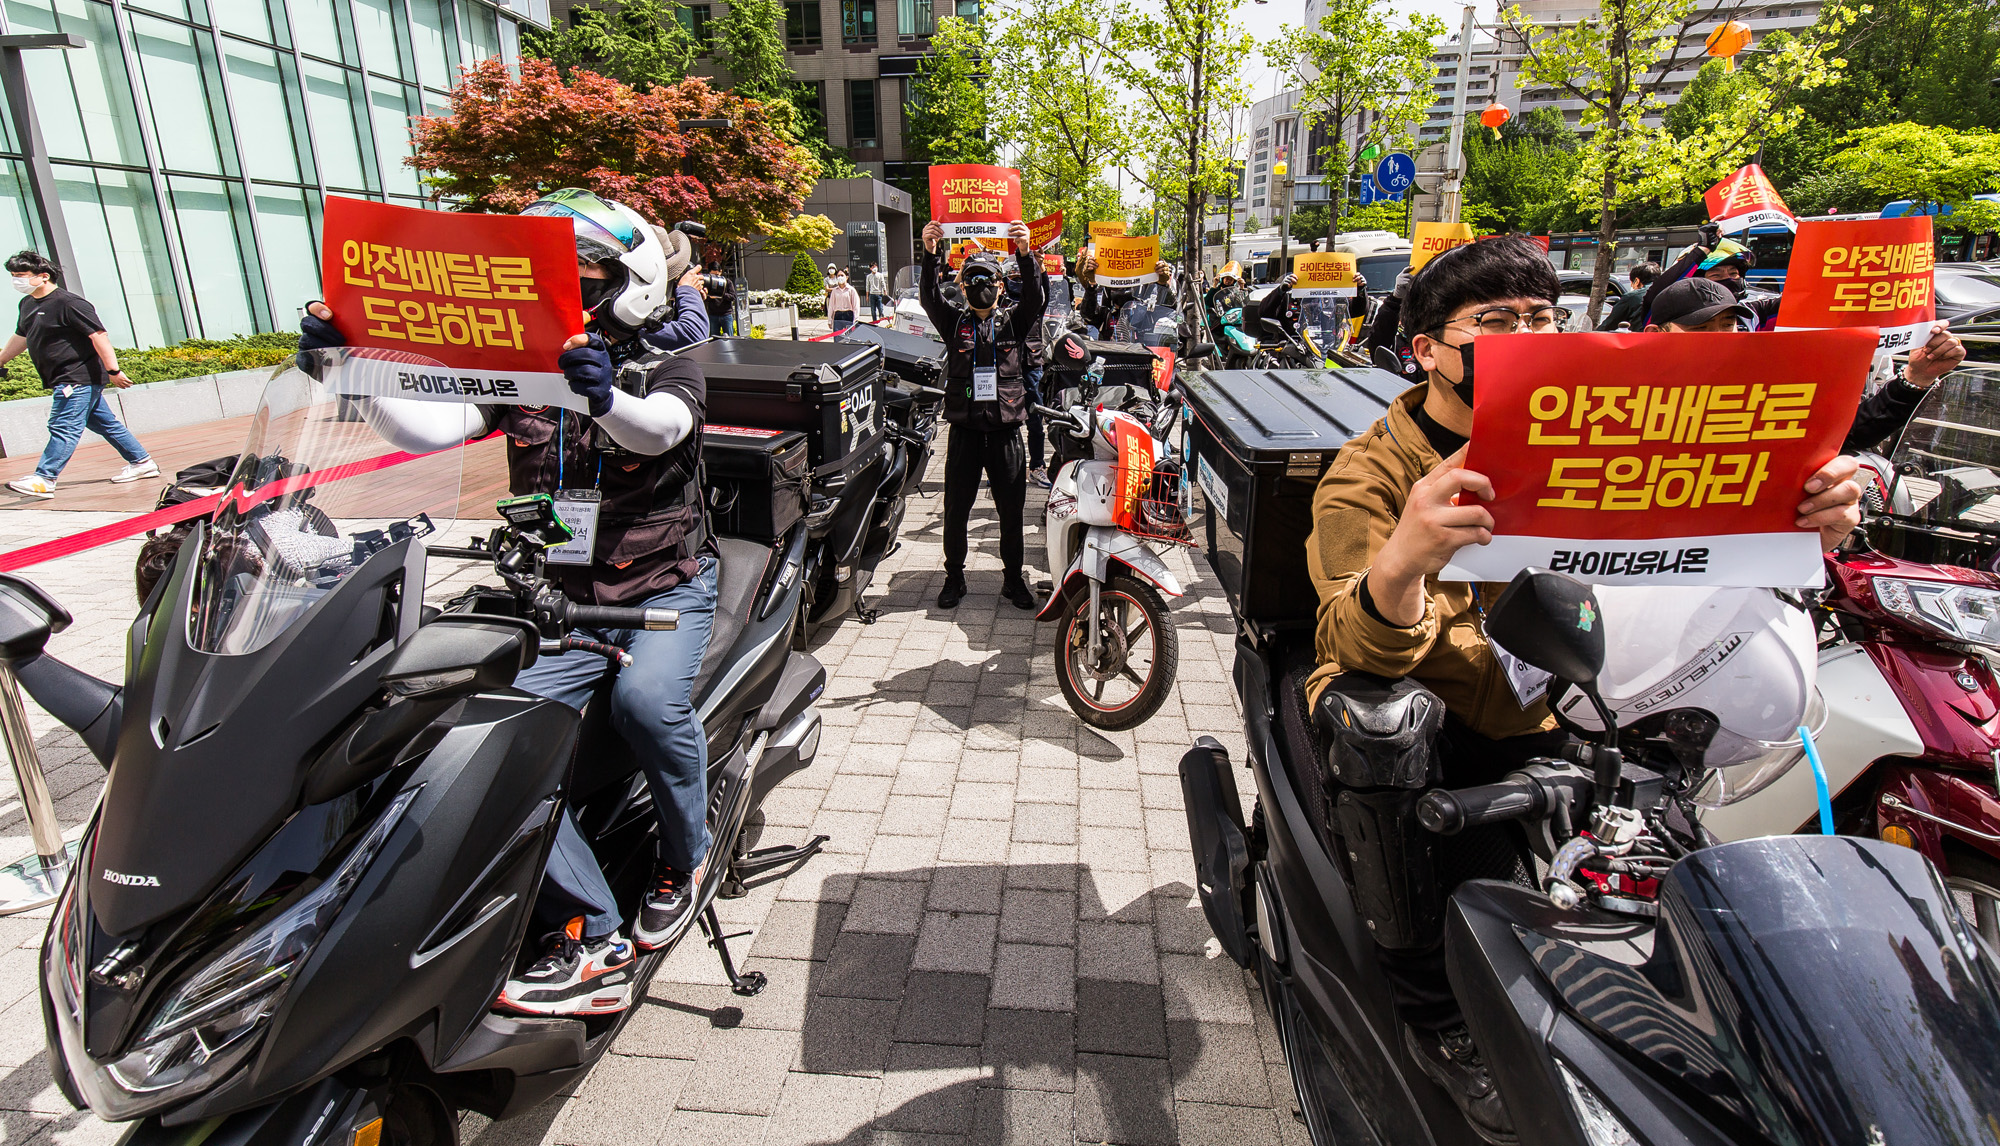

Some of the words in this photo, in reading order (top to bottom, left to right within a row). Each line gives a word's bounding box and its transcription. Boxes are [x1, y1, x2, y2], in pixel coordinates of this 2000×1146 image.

[942, 178, 1009, 196] 산재전속성
[948, 197, 1003, 214] 폐지하라
[955, 225, 997, 234] 라이더유니온
[1029, 231, 1053, 247] 지하라
[1099, 246, 1153, 260] 라이더보호법
[342, 239, 538, 300] 안전배달료
[1107, 259, 1145, 271] 제정하라
[1300, 262, 1351, 272] 라이더보호법
[1307, 271, 1343, 282] 제정하라
[1828, 276, 1931, 312] 도입하라
[362, 296, 525, 351] 도입하라
[398, 371, 519, 398] 라이더유니온
[1527, 382, 1818, 446] 안전배달료
[1536, 451, 1771, 511] 도입하라
[1549, 547, 1710, 576] 라이더유니온
[102, 868, 161, 887] HONDA
